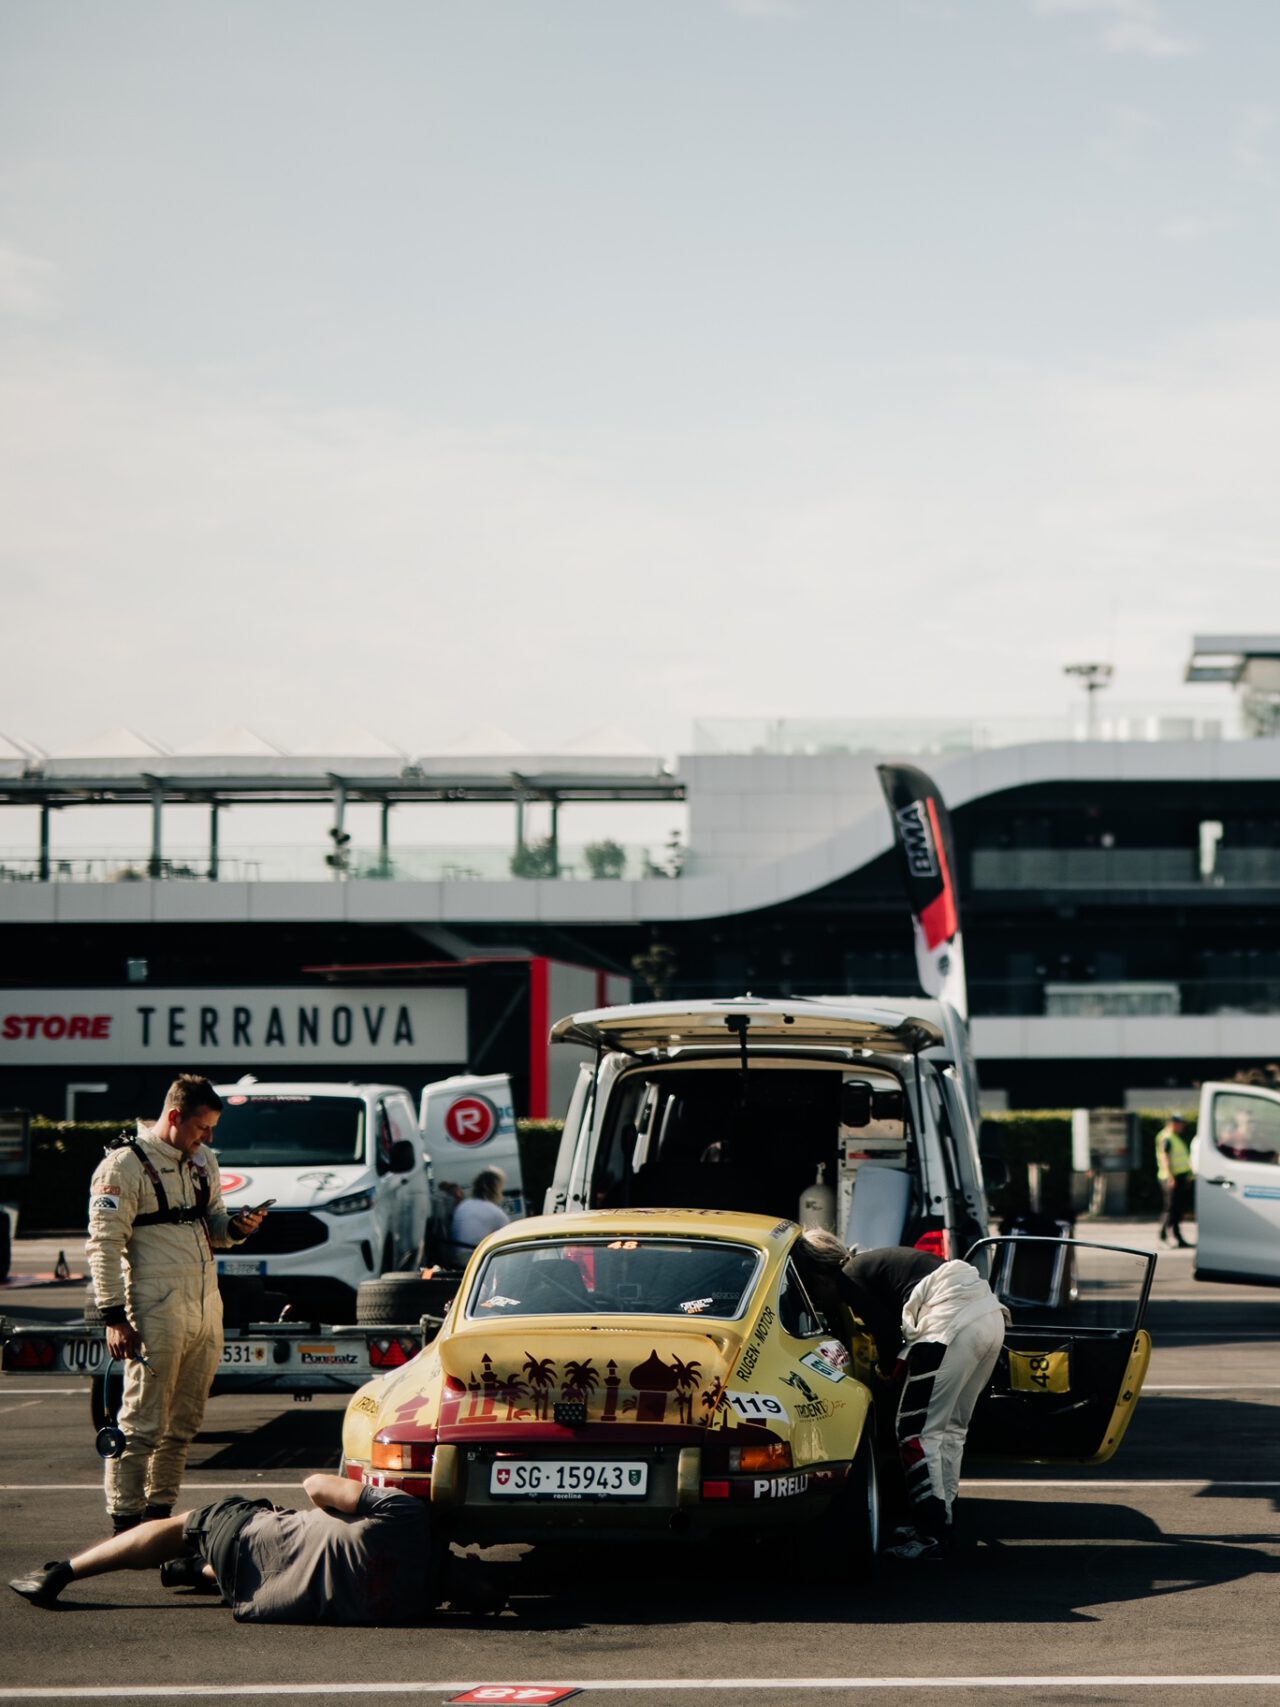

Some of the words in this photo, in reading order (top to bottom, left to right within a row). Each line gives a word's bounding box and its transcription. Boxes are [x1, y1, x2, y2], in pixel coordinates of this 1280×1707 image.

[2, 1014, 113, 1041] STORE
[137, 1005, 416, 1048] TERRANOVA
[455, 1106, 482, 1136] R
[607, 1240, 638, 1250] 48
[67, 1339, 100, 1367] 100
[736, 1341, 761, 1383] RUGEN
[754, 1306, 776, 1344] MOTOR
[302, 1353, 358, 1365] Pongratz
[1029, 1357, 1050, 1388] 48
[732, 1396, 782, 1414] 119
[753, 1475, 808, 1499] PIRELLI
[473, 1687, 557, 1700] 48
